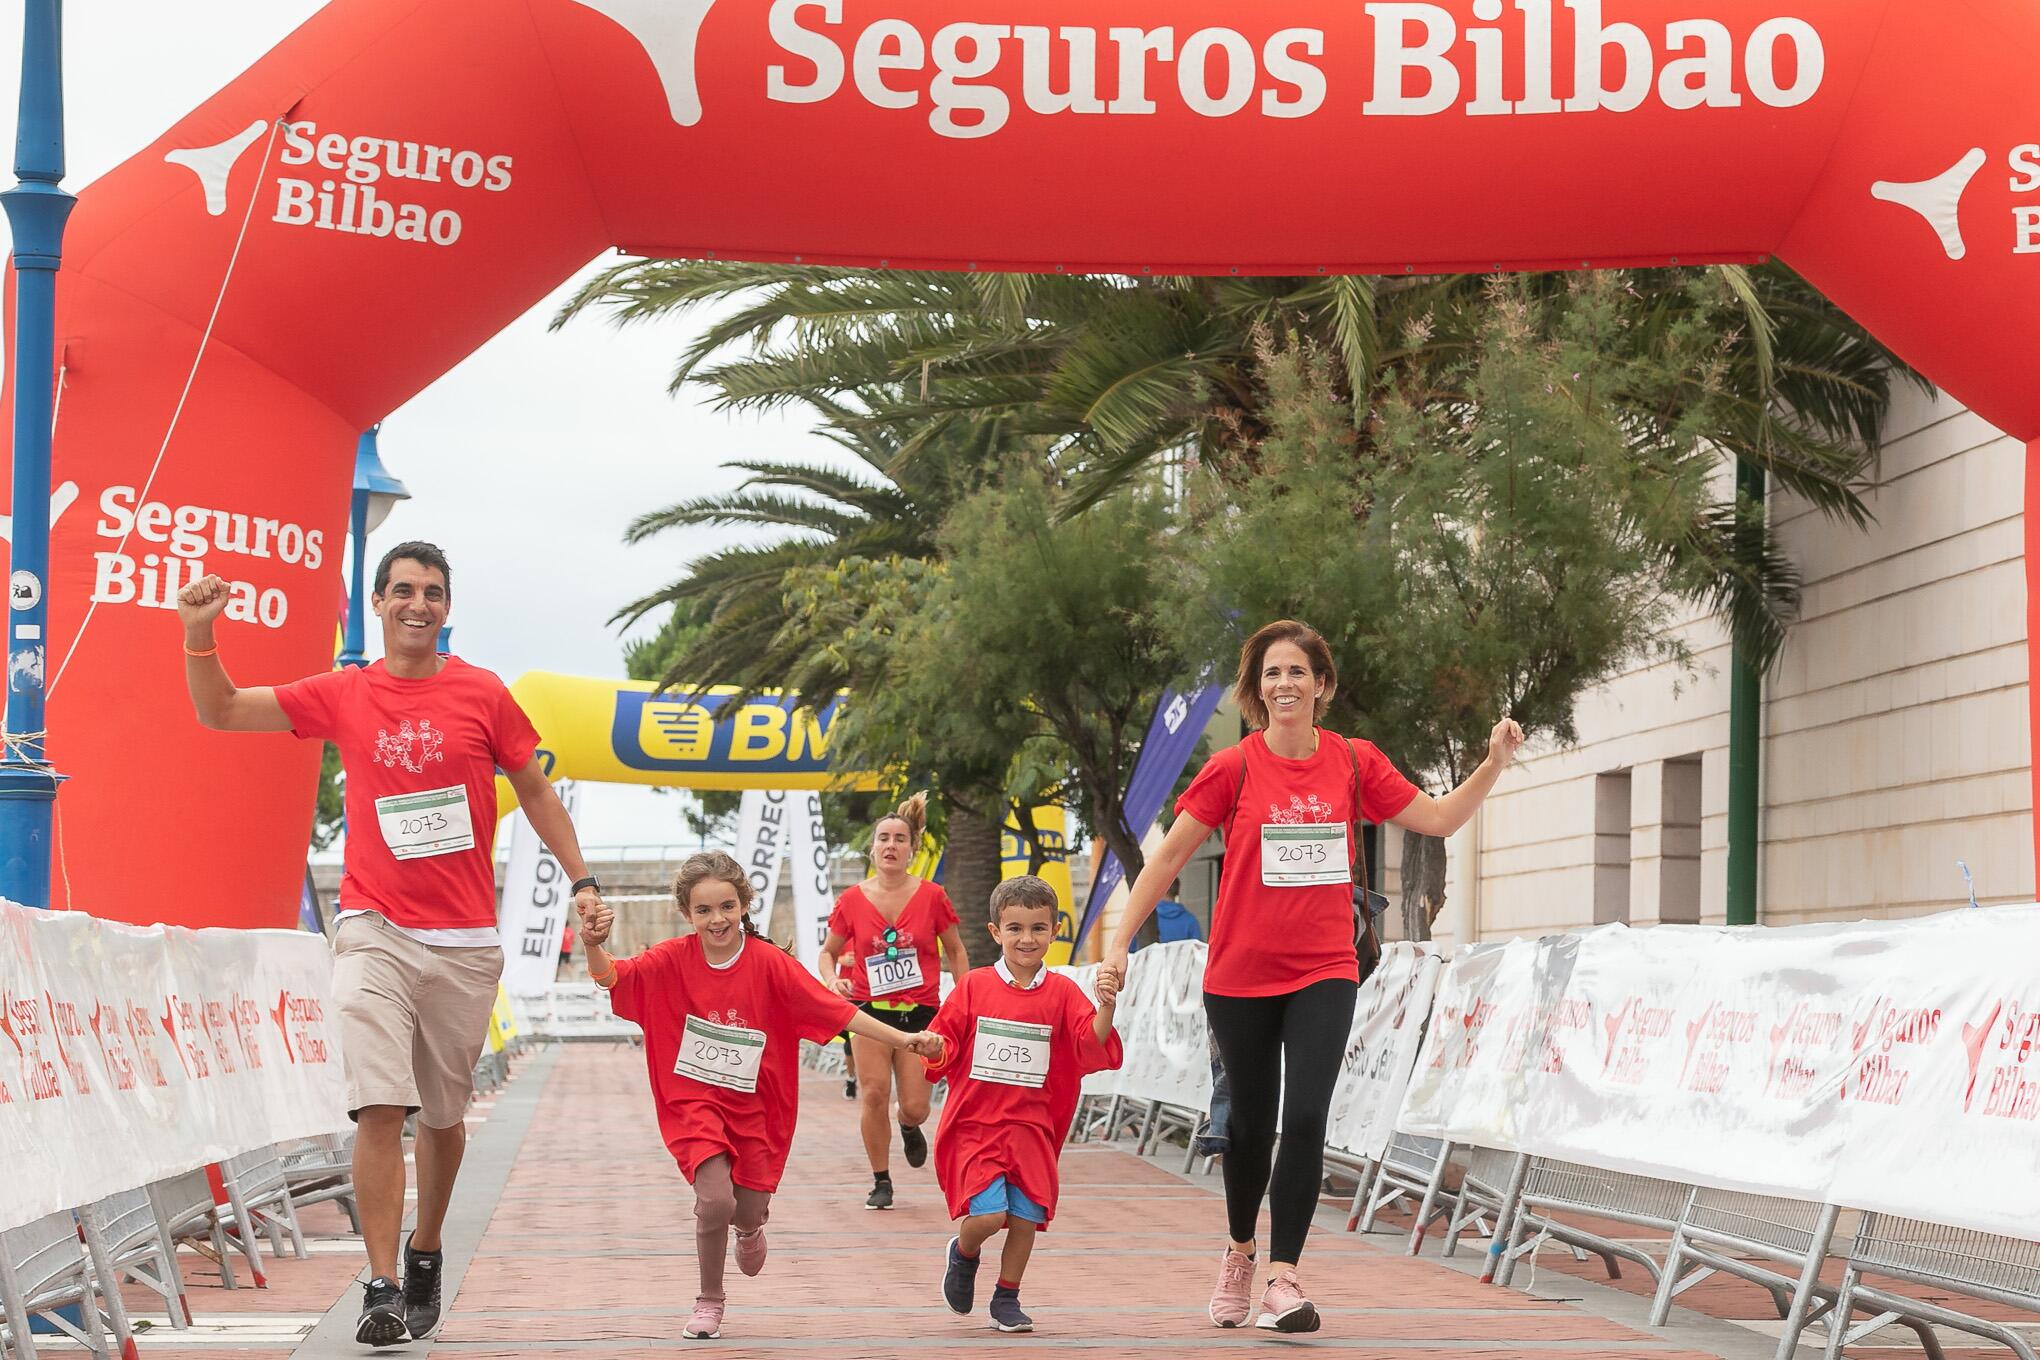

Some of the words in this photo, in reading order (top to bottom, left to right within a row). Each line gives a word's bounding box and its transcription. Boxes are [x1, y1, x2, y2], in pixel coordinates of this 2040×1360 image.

[767, 0, 1327, 138] Seguros
[1362, 0, 1826, 116] Bilbao
[279, 120, 513, 192] Seguros
[271, 177, 463, 247] Bilbao
[96, 485, 323, 570] Seguros
[400, 812, 448, 835] 2073
[1277, 843, 1327, 864] 2073
[874, 959, 916, 984] 1002
[695, 1040, 743, 1066] 2073
[986, 1042, 1032, 1063] 2073
